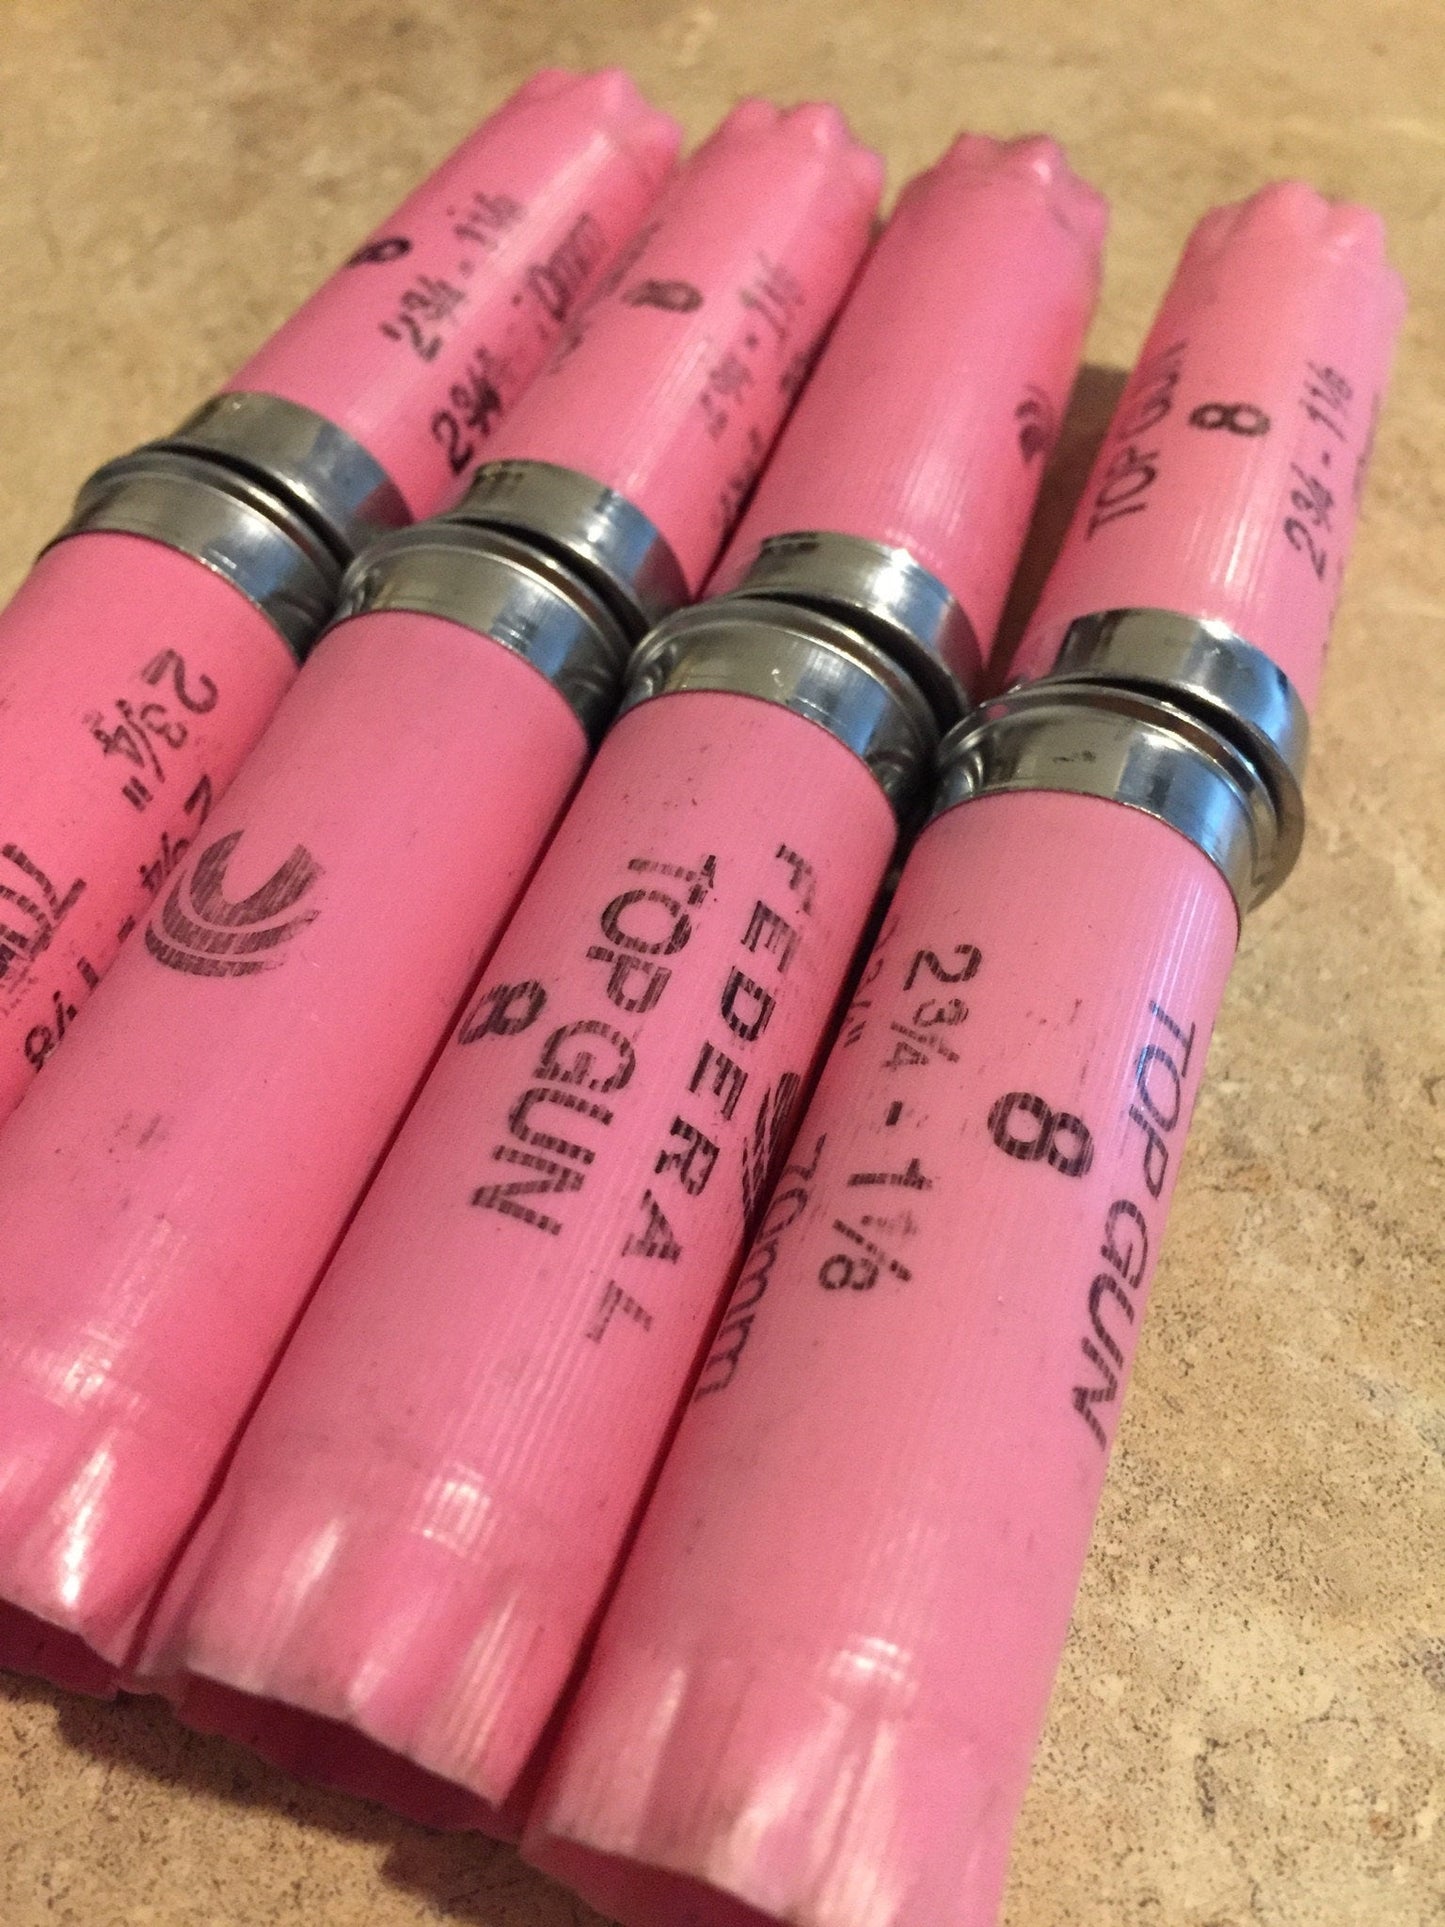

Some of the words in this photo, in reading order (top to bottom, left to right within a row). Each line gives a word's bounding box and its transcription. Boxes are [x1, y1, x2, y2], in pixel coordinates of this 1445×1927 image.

[1188, 402, 1272, 438] 8
[456, 978, 549, 1046] 8
[584, 843, 818, 1346] FEDERAL
[986, 1091, 1095, 1179] 8
